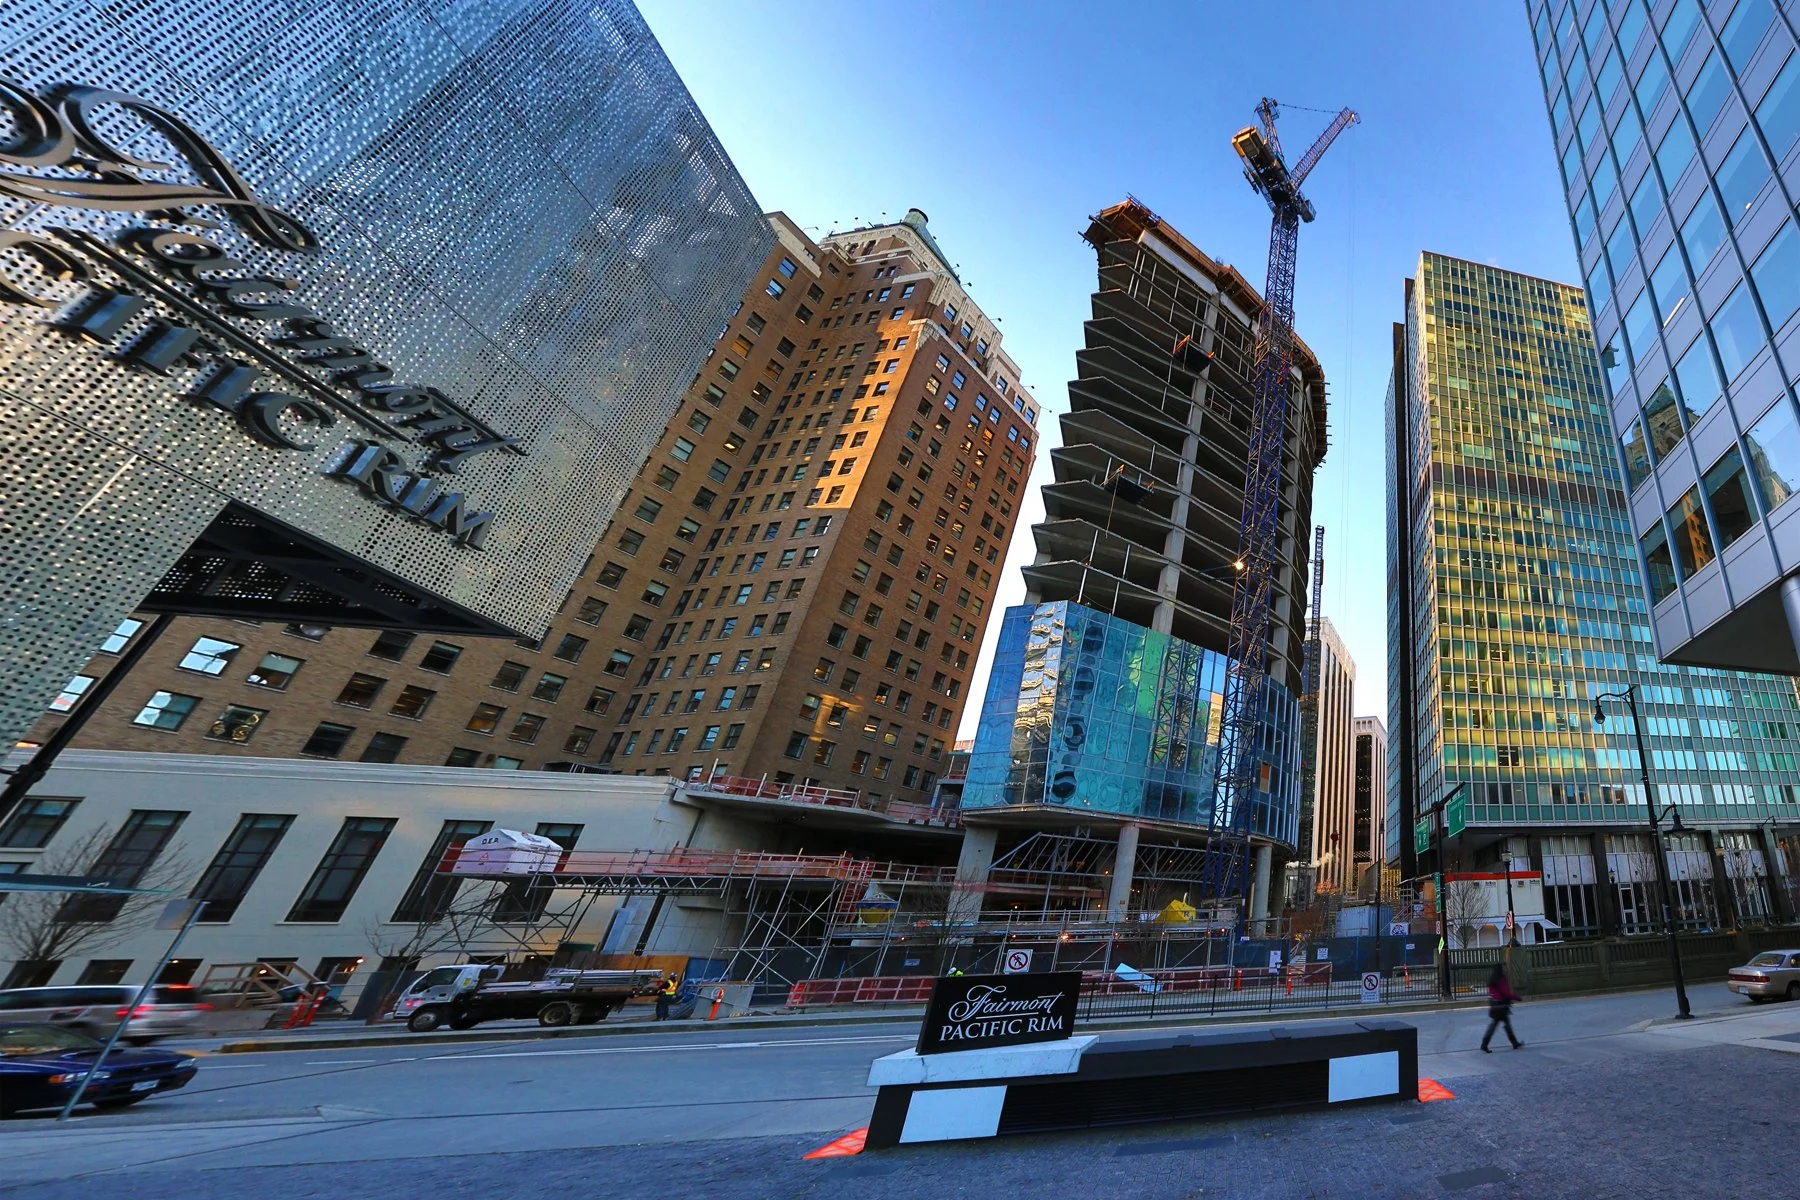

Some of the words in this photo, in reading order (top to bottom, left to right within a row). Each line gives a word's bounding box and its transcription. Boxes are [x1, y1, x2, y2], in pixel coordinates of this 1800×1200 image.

[318, 437, 497, 552] RIM
[948, 984, 1066, 1023] Fairmont
[939, 1019, 1022, 1042] PACIFIC
[1027, 1015, 1064, 1033] RIM
